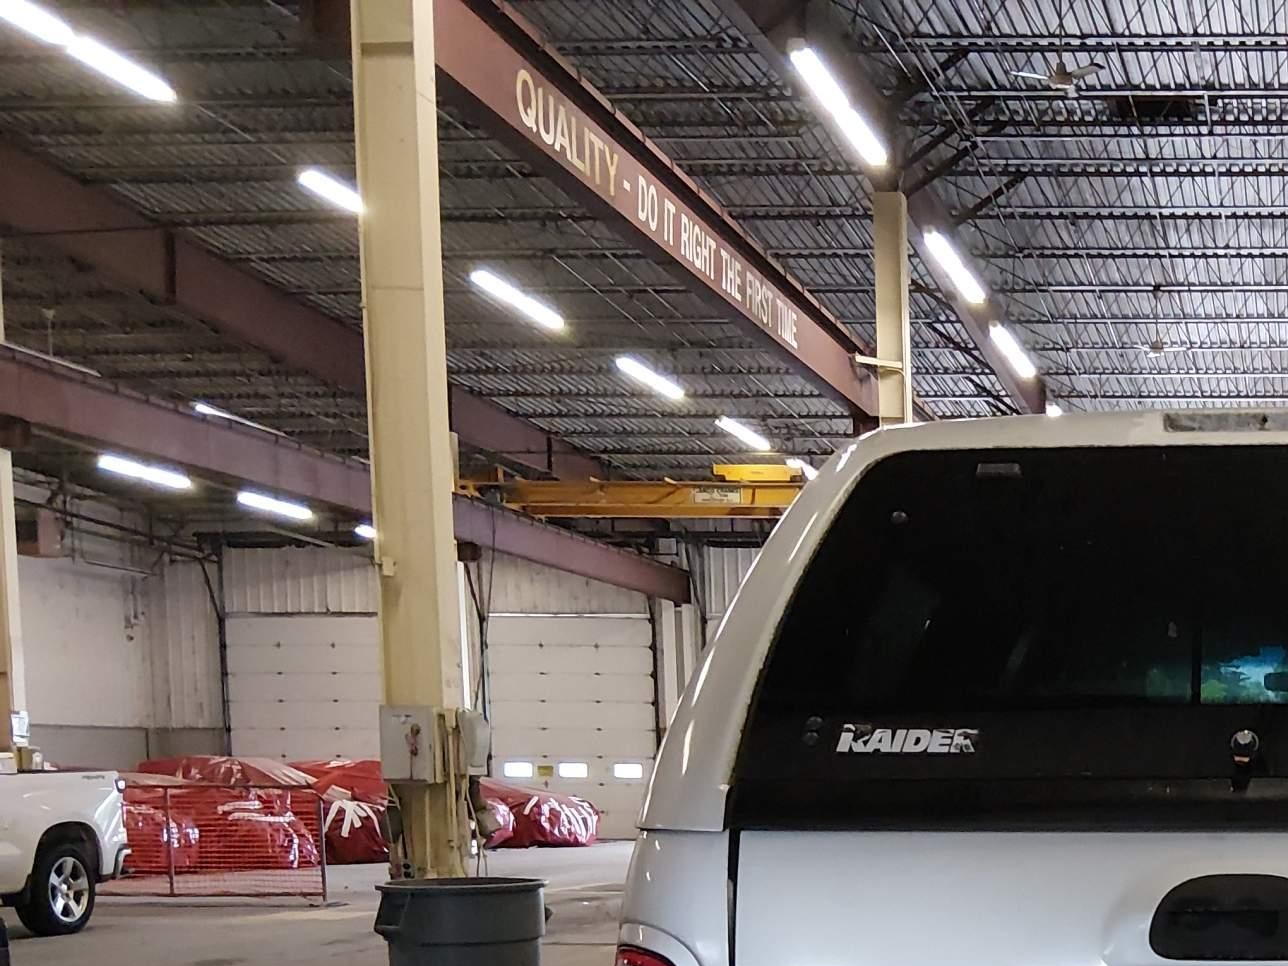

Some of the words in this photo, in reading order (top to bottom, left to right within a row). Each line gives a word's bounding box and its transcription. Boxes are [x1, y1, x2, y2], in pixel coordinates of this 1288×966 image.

[516, 69, 619, 196] QUALITY
[638, 175, 658, 232] DO
[664, 198, 676, 247] IT
[681, 213, 716, 281] RIGHT
[720, 248, 742, 302] THE
[746, 271, 773, 328] FIRST
[776, 298, 798, 350] TIME
[836, 724, 979, 753] RAIDER
